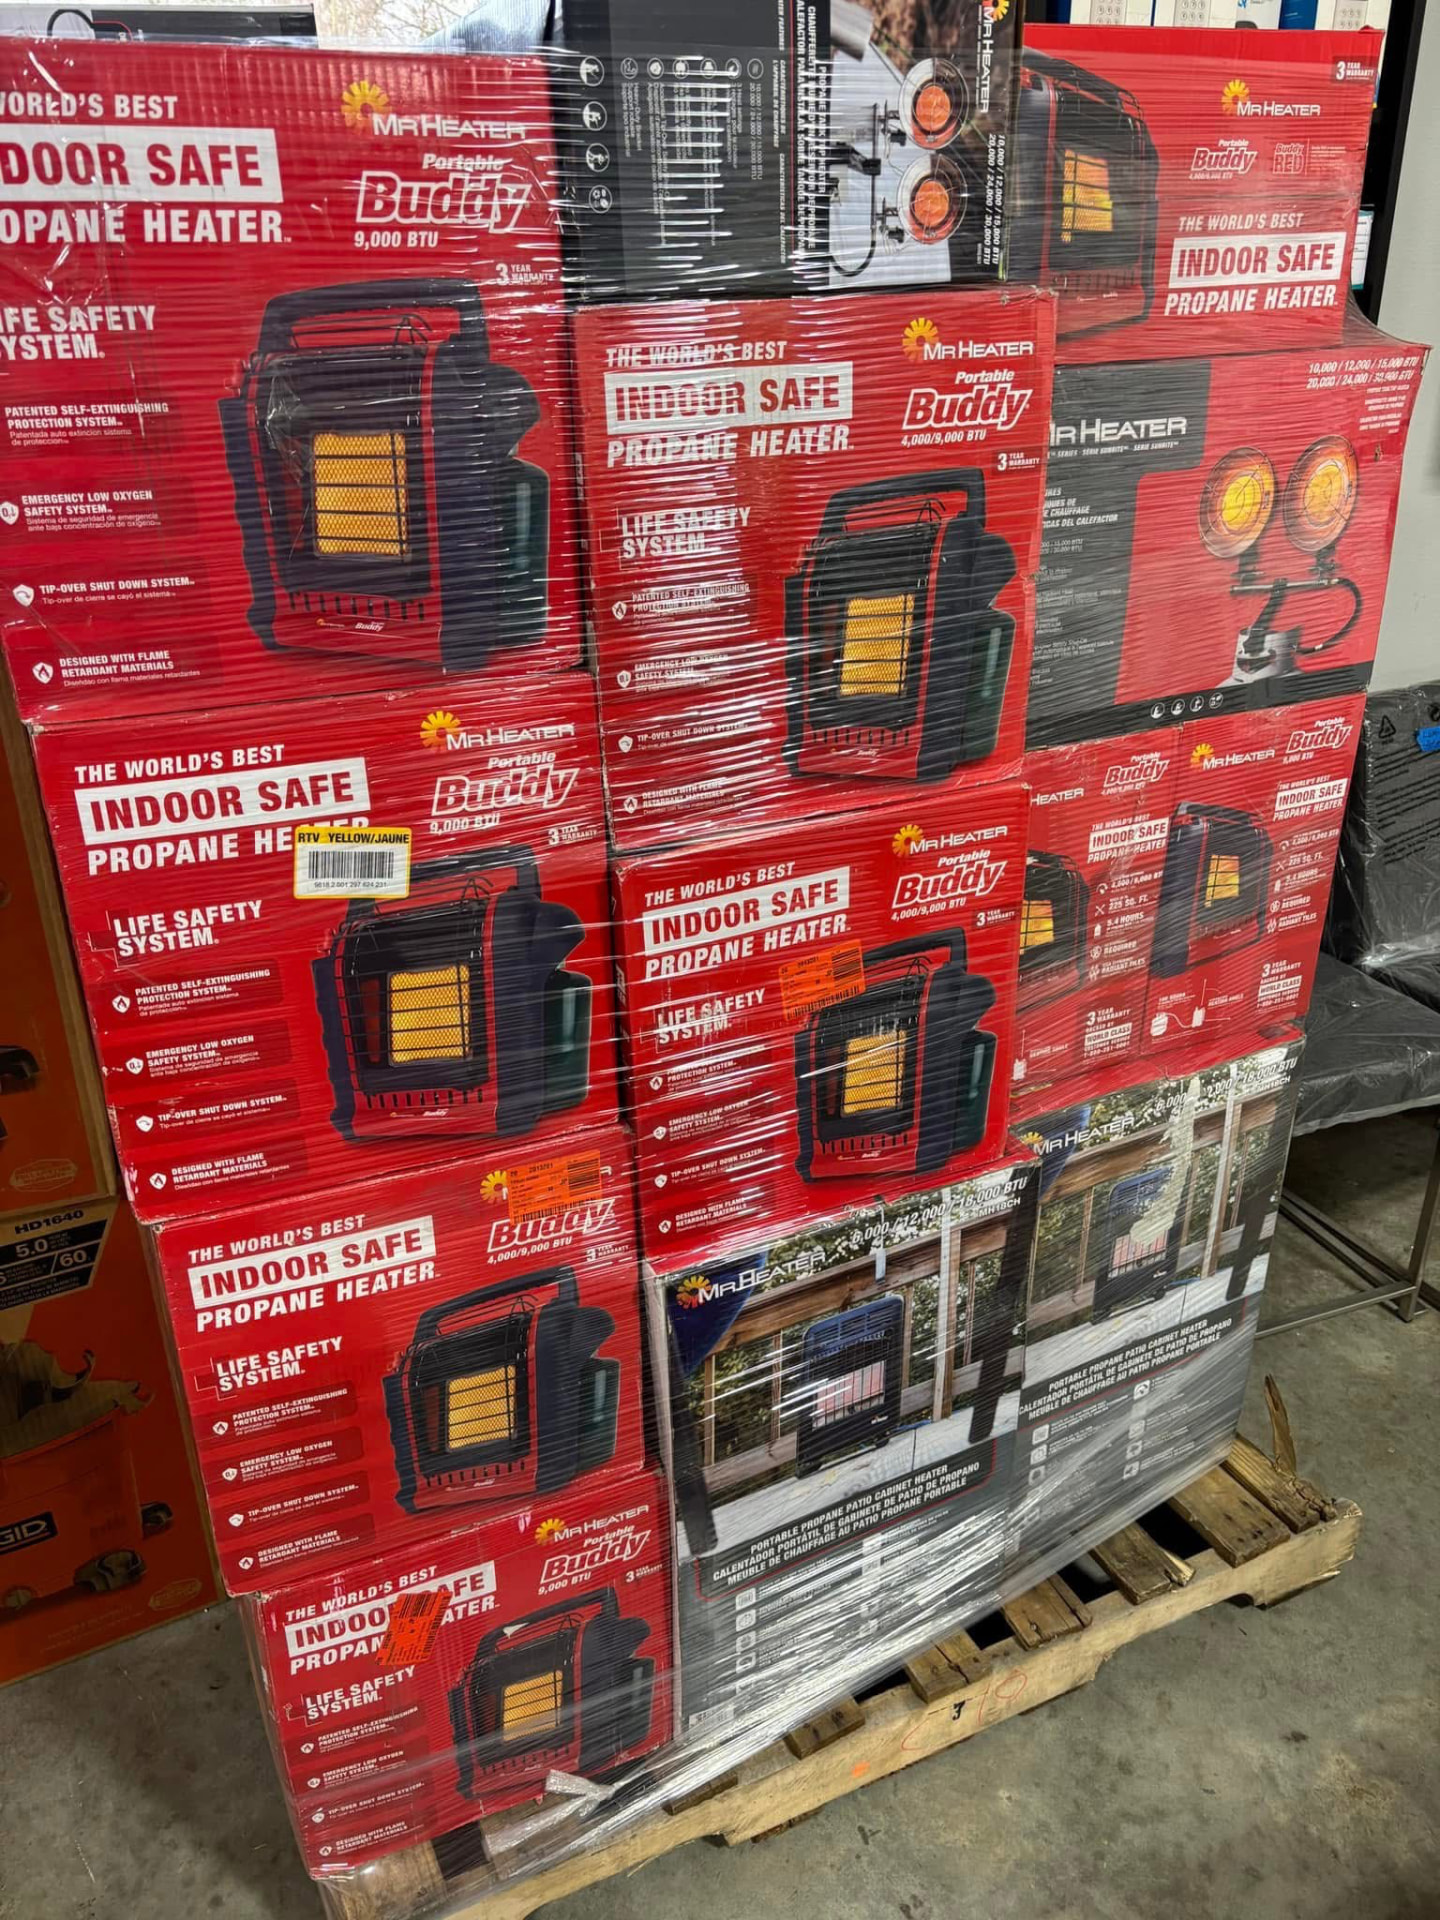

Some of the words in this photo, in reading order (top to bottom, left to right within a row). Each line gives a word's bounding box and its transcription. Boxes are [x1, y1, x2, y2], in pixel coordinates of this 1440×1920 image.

[981, 40, 994, 113] HEATER
[1335, 61, 1345, 81] 3
[0, 92, 103, 118] ORLD'S
[115, 94, 178, 119] BEST
[1237, 101, 1262, 117] MR
[1263, 102, 1321, 117] HEATER
[372, 113, 418, 136] MR
[421, 114, 526, 139] HEATER
[147, 144, 263, 187] SAFE
[422, 153, 504, 171] Portable
[1190, 147, 1257, 173] Buddy
[356, 171, 532, 234] Buddy
[1179, 216, 1204, 231] THE
[1207, 213, 1267, 231] WORLD'S
[1270, 213, 1304, 229] BEST
[354, 231, 402, 250] 9,000
[407, 231, 438, 248] BTU
[1177, 245, 1271, 278] INDOOR
[1276, 243, 1336, 273] SAFE
[495, 263, 509, 286] 3
[1164, 288, 1258, 317] PROPANE
[50, 306, 155, 332] SAFETY
[605, 347, 643, 368] THE
[650, 343, 735, 366] WORLD'S
[741, 341, 788, 361] BEST
[923, 342, 955, 361] MR
[958, 340, 1034, 360] HEATER
[955, 369, 1015, 385] Portable
[5, 406, 58, 417] PATENTED
[60, 402, 169, 415] SELF-EXTINGUISHING
[615, 380, 746, 422] INDOOR
[759, 375, 840, 413] SAFE
[902, 382, 1033, 431] Buddy
[8, 417, 72, 429] PROTECTION
[1080, 416, 1188, 444] HEATER
[607, 431, 738, 468] PROPANE
[901, 431, 964, 448] 4,000/9,000
[967, 429, 987, 442] BTU
[997, 453, 1008, 471] 3
[21, 493, 84, 505] EMERGENCY
[87, 491, 110, 502] LOW
[113, 490, 153, 501] OXYGEN
[24, 506, 62, 517] SAFETY
[621, 513, 668, 537] LIFE
[672, 506, 750, 533] SAFETY
[1076, 514, 1119, 526] CALEFACTOR
[39, 583, 87, 595] TIP-OVER
[89, 581, 116, 592] SHUT
[118, 579, 148, 590] DOWN
[59, 655, 108, 668] DESIGNED
[110, 653, 135, 664] WITH
[138, 650, 170, 662] FLAME
[61, 665, 119, 678] RETARDANT
[121, 661, 174, 673] MATERIALS
[447, 732, 484, 750] MR
[487, 723, 575, 746] HEATER
[1286, 725, 1353, 754] Buddy
[75, 763, 118, 784] THE
[124, 751, 225, 780] WORLD'S
[232, 744, 285, 767] BEST
[488, 751, 556, 769] Portable
[1225, 749, 1275, 767] HEATER
[1103, 760, 1169, 787] Buddy
[90, 785, 244, 833] INDOOR
[257, 771, 355, 813] SAFE
[432, 763, 580, 816] Buddy
[1031, 788, 1084, 806] HEATER
[1279, 789, 1315, 807] INDOOR
[1319, 783, 1343, 799] SAFE
[298, 832, 320, 844] RTV
[328, 832, 410, 845] YELLOW/JAUNE
[910, 839, 938, 855] MR
[941, 825, 1008, 849] HEATER
[1093, 827, 1135, 849] INDOOR
[1139, 822, 1167, 838] SAFE
[88, 833, 240, 876] PROPANE
[937, 849, 991, 868] Portable
[645, 888, 675, 907] THE
[680, 872, 750, 900] WORLD'S
[757, 861, 795, 883] BEST
[892, 859, 1008, 909] Buddy
[113, 914, 169, 938] LIFE
[175, 900, 264, 930] SAFETY
[652, 897, 760, 945] INDOOR
[772, 878, 839, 917] SAFE
[891, 902, 947, 922] 4,000/9,000
[645, 936, 754, 981] PROPANE
[657, 1007, 696, 1030] LIFE
[701, 988, 766, 1019] SAFETY
[146, 1045, 198, 1059] EMERGENCY
[200, 1040, 219, 1050] LOW
[221, 1035, 255, 1047] OXYGEN
[199, 1105, 220, 1116] SHUT
[223, 1101, 248, 1112] DOWN
[1064, 1117, 1135, 1149] HEATER
[1003, 1176, 1028, 1195] BTU
[15, 1210, 84, 1234] HD1640
[16, 1239, 48, 1258] 5.0
[188, 1245, 224, 1264] THE
[230, 1227, 314, 1255] WORLD'S
[321, 1214, 366, 1237] BEST
[60, 1250, 87, 1268] 60
[200, 1251, 329, 1299] INDOOR
[341, 1228, 423, 1269] SAFE
[736, 1251, 826, 1291] HEATER
[196, 1287, 325, 1333] PROPANE
[216, 1356, 262, 1378] LIFE
[266, 1336, 343, 1366] SAFETY
[554, 1526, 582, 1542] MR
[584, 1504, 649, 1532] HEATER
[750, 1526, 799, 1554] PORTABLE
[801, 1507, 844, 1532] PROPANE
[846, 1496, 872, 1514] PATIO
[874, 1480, 913, 1502] CABINET
[915, 1465, 948, 1485] HEATER
[583, 1525, 635, 1548] Portable
[713, 1551, 776, 1582] CALENTADOR
[837, 1504, 884, 1529] GABINETE
[540, 1529, 651, 1584] Buddy
[727, 1564, 767, 1586] MEUBLE
[783, 1532, 837, 1561] CHAUFFAGE
[285, 1605, 316, 1622] THE
[321, 1581, 393, 1611] WORLD'S
[399, 1565, 438, 1587] BEST
[538, 1579, 568, 1596] 9,000
[571, 1571, 591, 1585] BTU
[306, 1688, 344, 1709] LIFE
[349, 1665, 416, 1696] SAFETY
